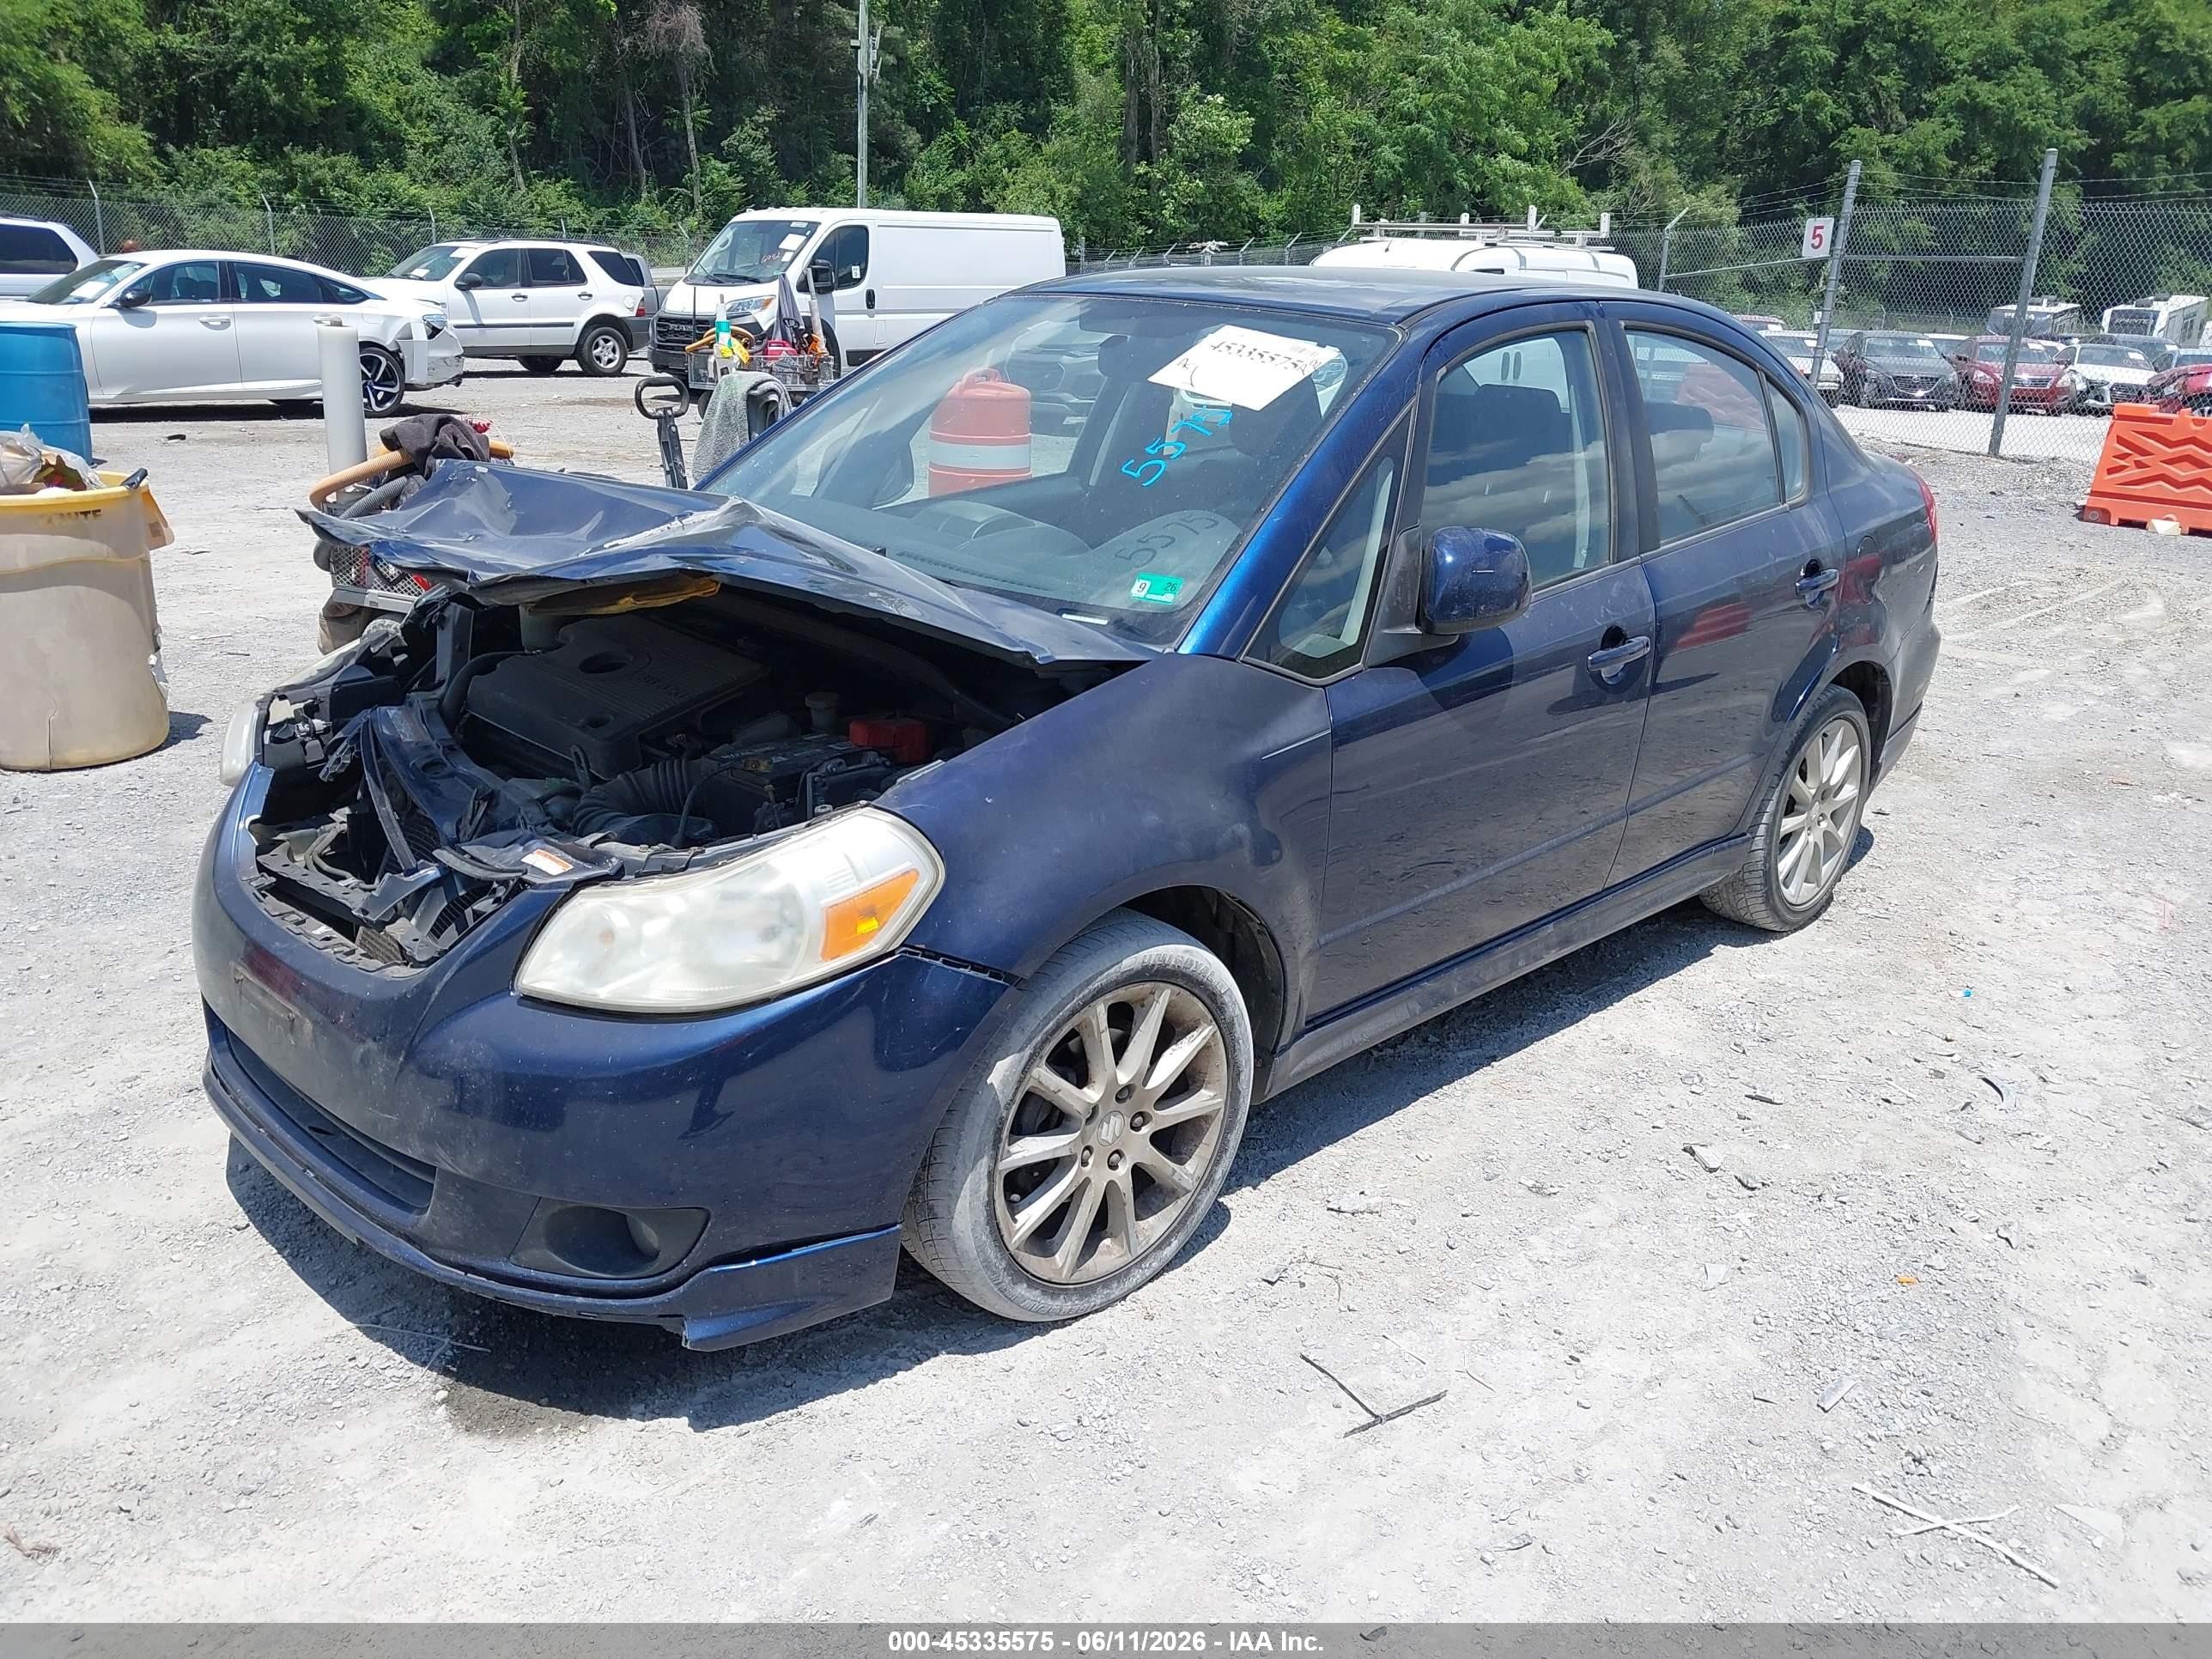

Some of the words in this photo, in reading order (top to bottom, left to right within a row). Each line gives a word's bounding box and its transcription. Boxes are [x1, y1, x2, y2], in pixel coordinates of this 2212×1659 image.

[1811, 225, 1825, 250] 5
[1210, 341, 1304, 370] 45335575
[1137, 582, 1147, 593] 9
[1164, 582, 1177, 592] 26
